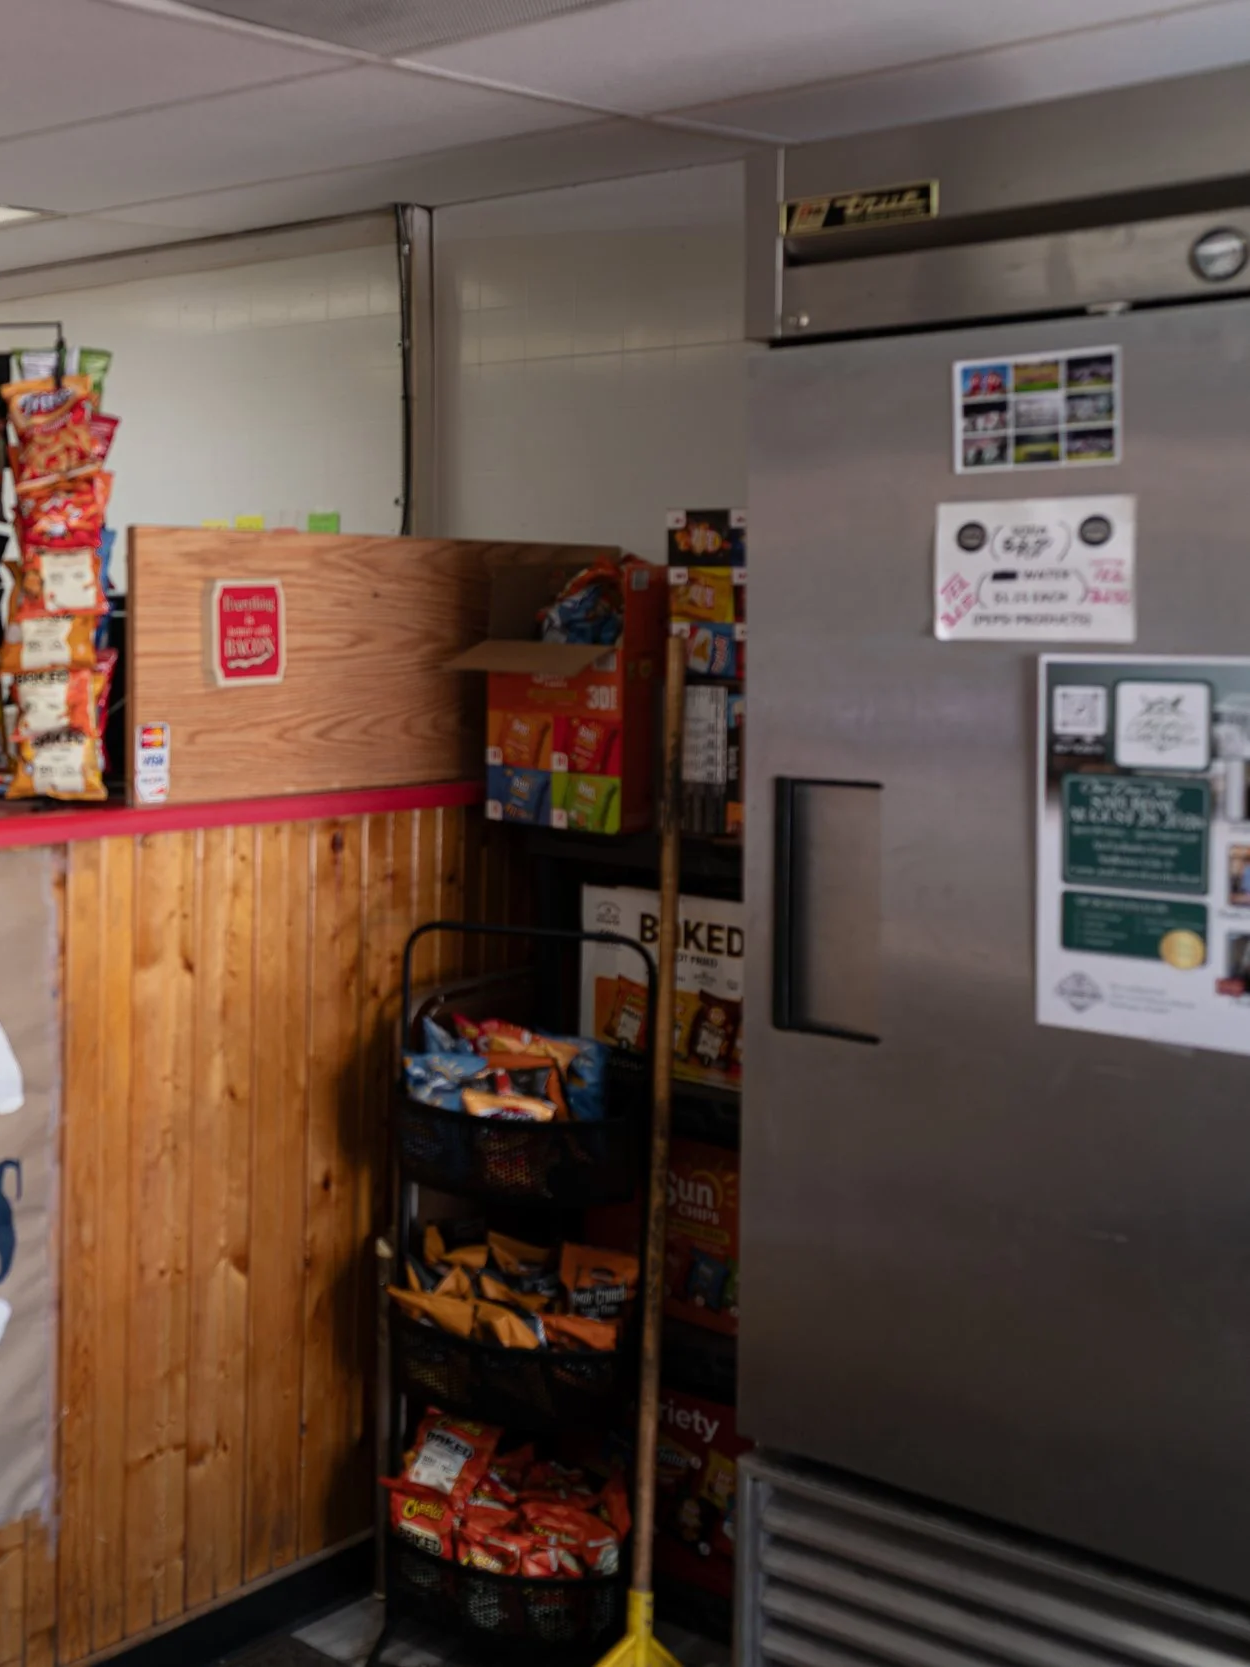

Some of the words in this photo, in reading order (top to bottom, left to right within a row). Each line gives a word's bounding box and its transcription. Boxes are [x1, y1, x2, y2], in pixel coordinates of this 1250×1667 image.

[639, 912, 745, 958] BKED
[677, 1202, 720, 1226] CHIPS
[657, 1398, 721, 1444] riety
[402, 1498, 446, 1521] Cheetos
